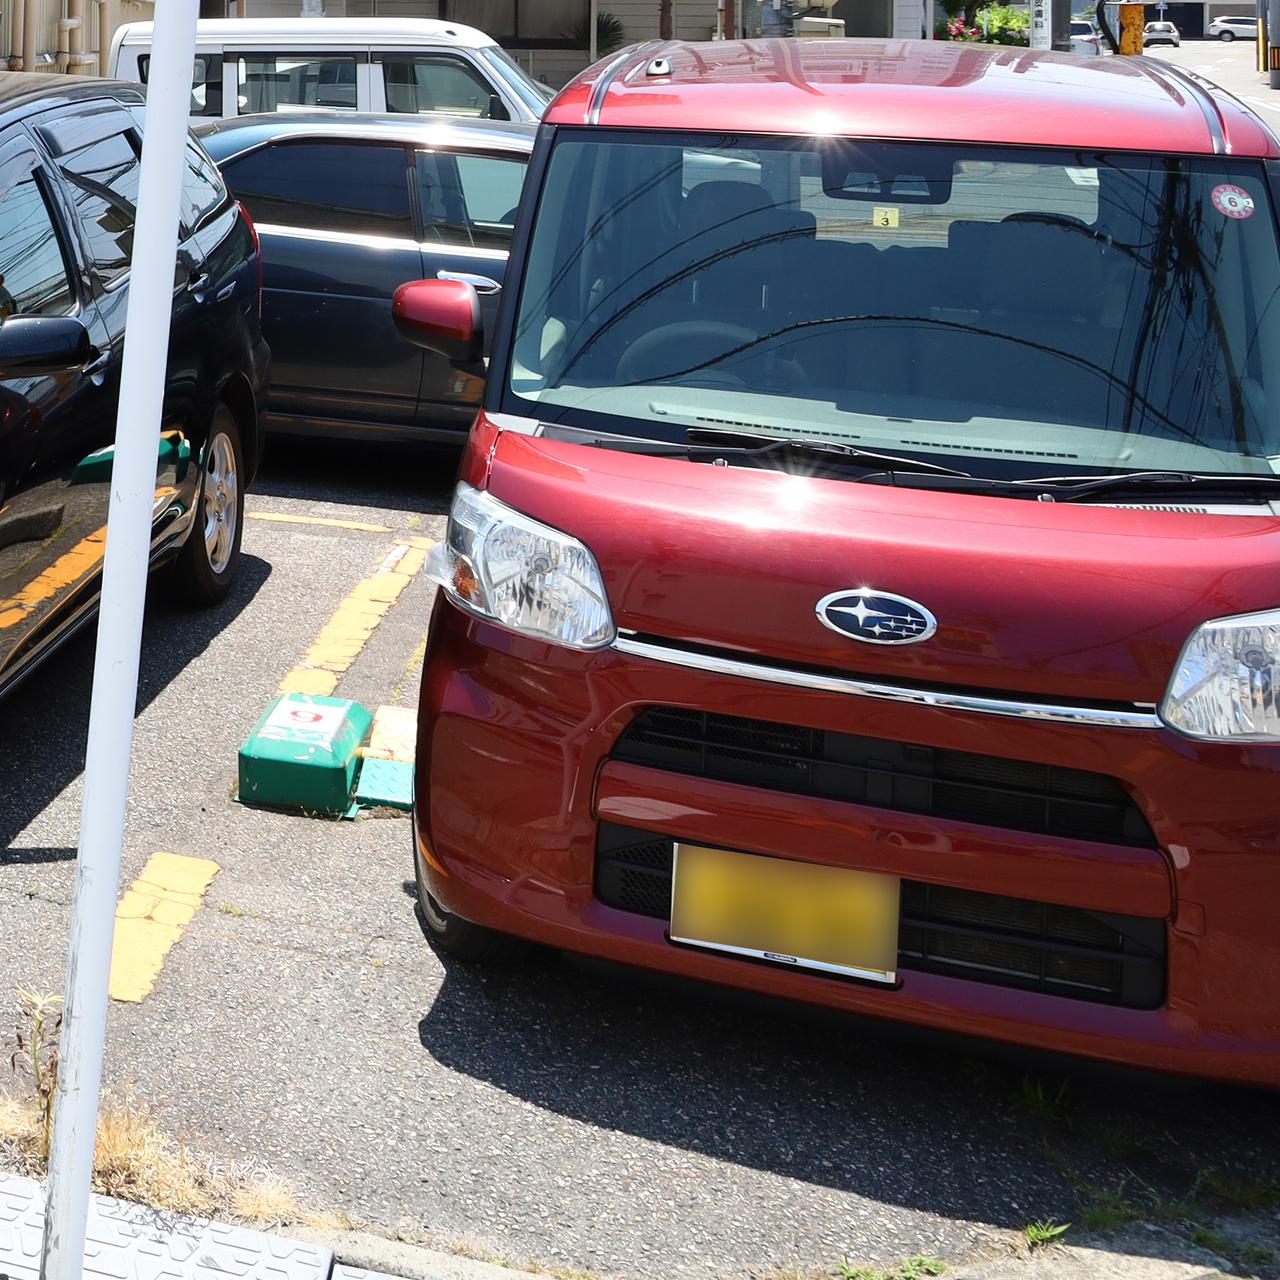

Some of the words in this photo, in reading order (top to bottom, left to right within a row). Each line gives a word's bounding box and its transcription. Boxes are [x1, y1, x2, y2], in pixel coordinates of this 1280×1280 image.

[1228, 197, 1238, 208] 6
[881, 217, 889, 226] 3
[289, 710, 323, 723] 9
